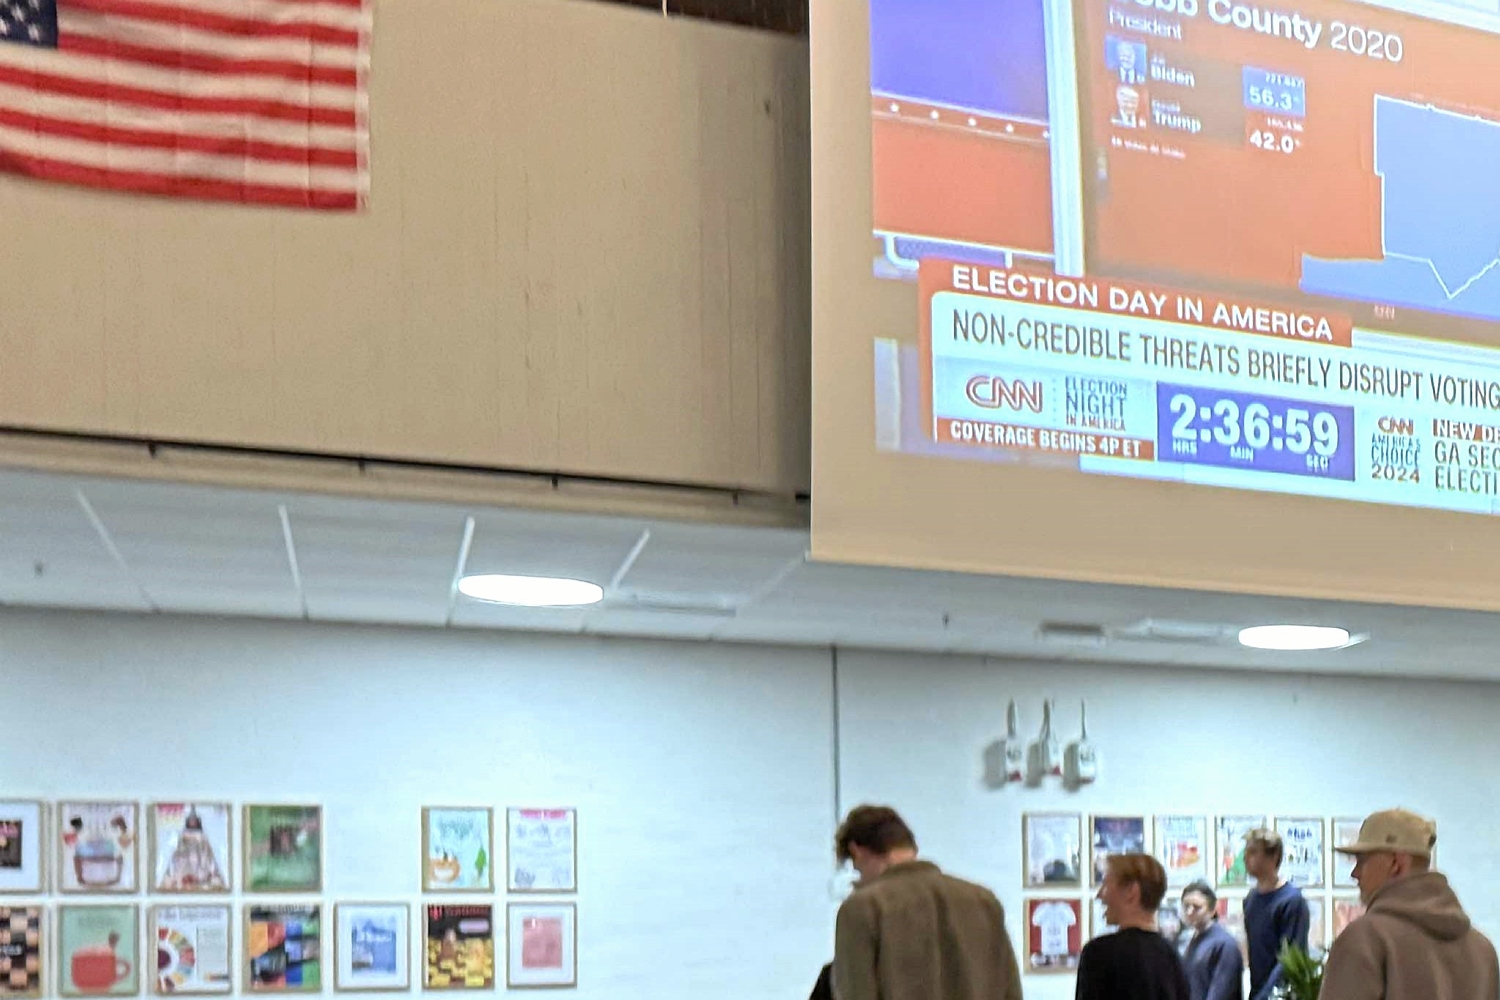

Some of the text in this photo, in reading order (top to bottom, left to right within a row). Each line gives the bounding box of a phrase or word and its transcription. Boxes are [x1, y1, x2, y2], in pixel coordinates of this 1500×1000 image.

[1108, 6, 1181, 40] President
[1207, 0, 1321, 48] County
[1330, 21, 1403, 62] 2020
[1151, 64, 1195, 88] Biden
[1154, 110, 1201, 133] Trump
[953, 264, 1333, 341] ELECTION DAY IN AMERICA
[953, 309, 1131, 362] NON-CREDIBLE
[1139, 333, 1240, 375] THREATS
[1248, 348, 1331, 389] BRIEFLY
[1339, 360, 1423, 400] DISRUPT
[1430, 373, 1500, 410] VOTING
[966, 373, 1043, 414] CNN
[1065, 376, 1127, 396] ELECTION
[1066, 391, 1127, 418] NIGHT
[1081, 414, 1126, 431] AMERICA
[1170, 393, 1339, 457] 2:36:59
[1378, 415, 1414, 436] CNN
[1437, 418, 1476, 441] NEW
[951, 420, 1035, 447] COVERAGE
[1039, 429, 1096, 454] BEGINS
[1122, 440, 1141, 458] ET
[1172, 438, 1197, 456] HRS
[1230, 445, 1254, 463] MIN
[1371, 445, 1421, 467] CHOICE
[1435, 440, 1461, 466] GA
[1371, 463, 1420, 484] 2024
